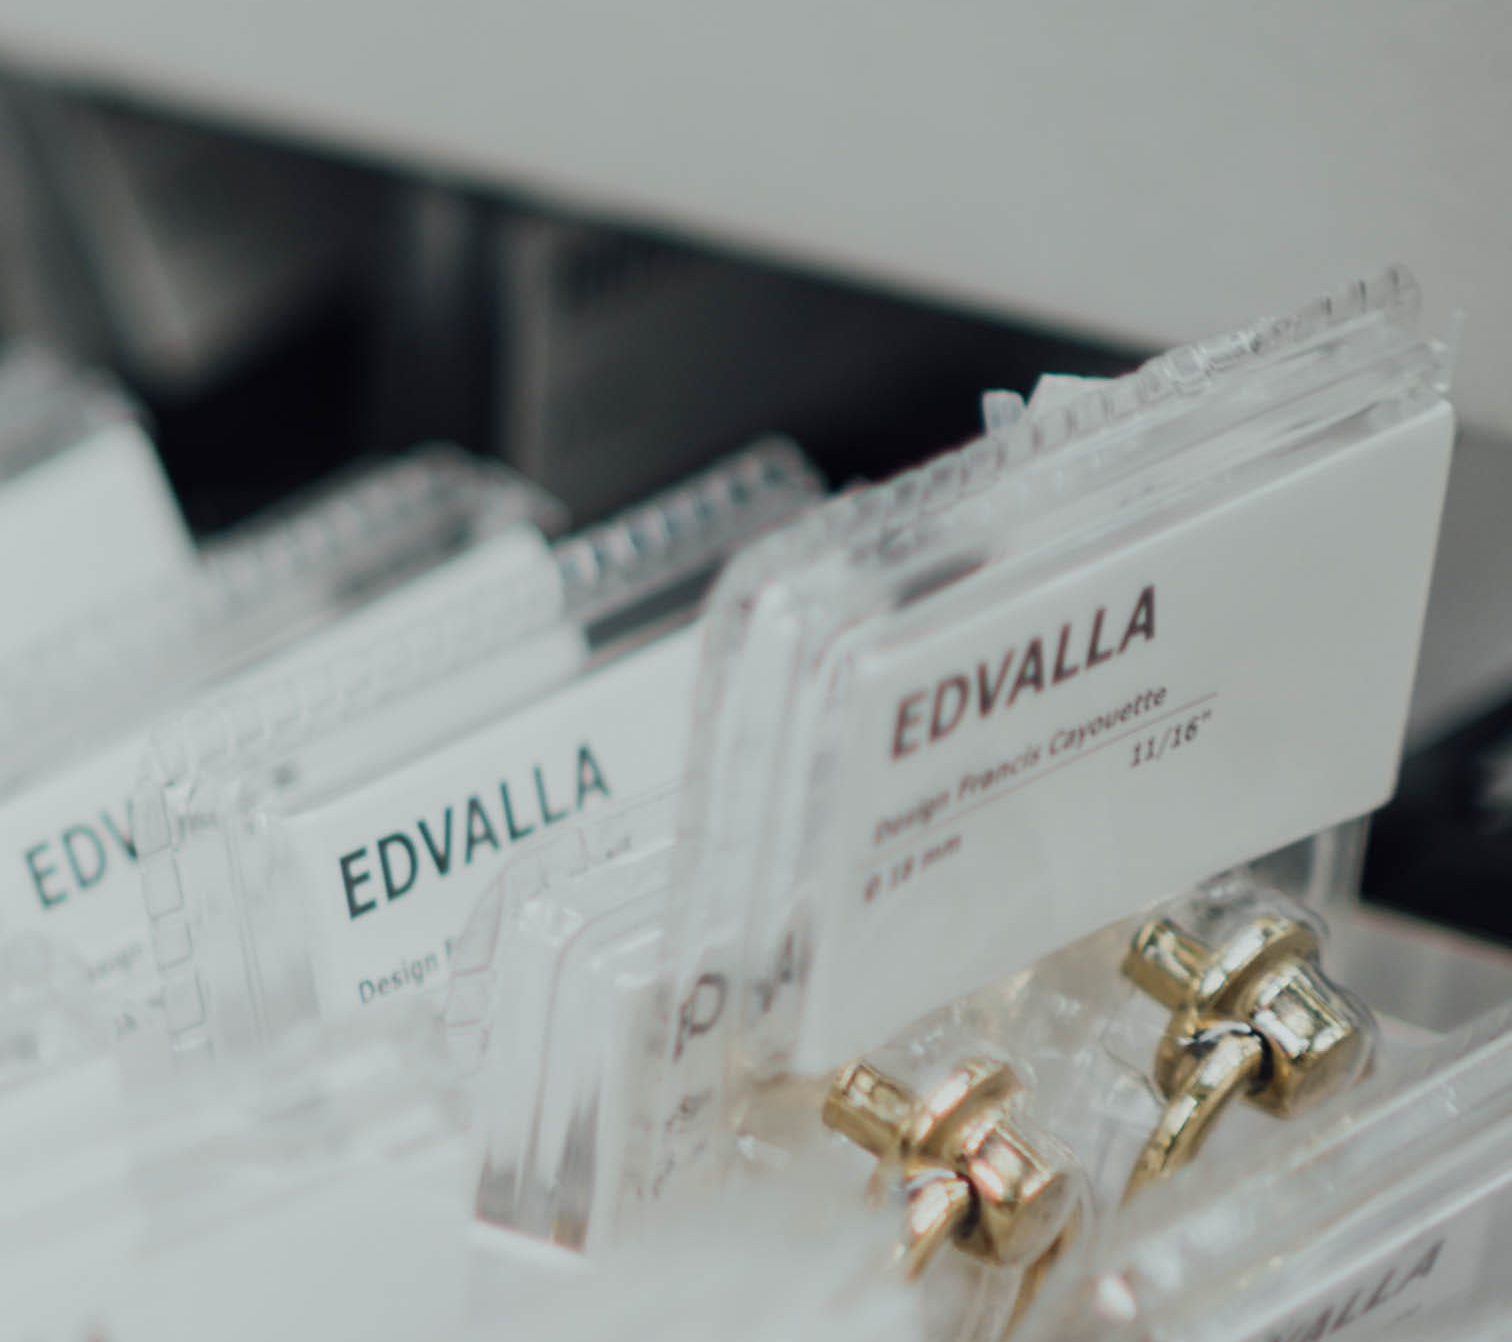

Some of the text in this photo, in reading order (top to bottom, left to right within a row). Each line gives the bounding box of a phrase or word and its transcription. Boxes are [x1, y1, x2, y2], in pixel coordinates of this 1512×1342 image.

[887, 580, 1160, 765] EDVALLA
[957, 743, 1045, 801] Francis
[1046, 685, 1170, 758] Cayouette
[336, 740, 613, 921] EDVALLA
[357, 951, 441, 1007] Design
